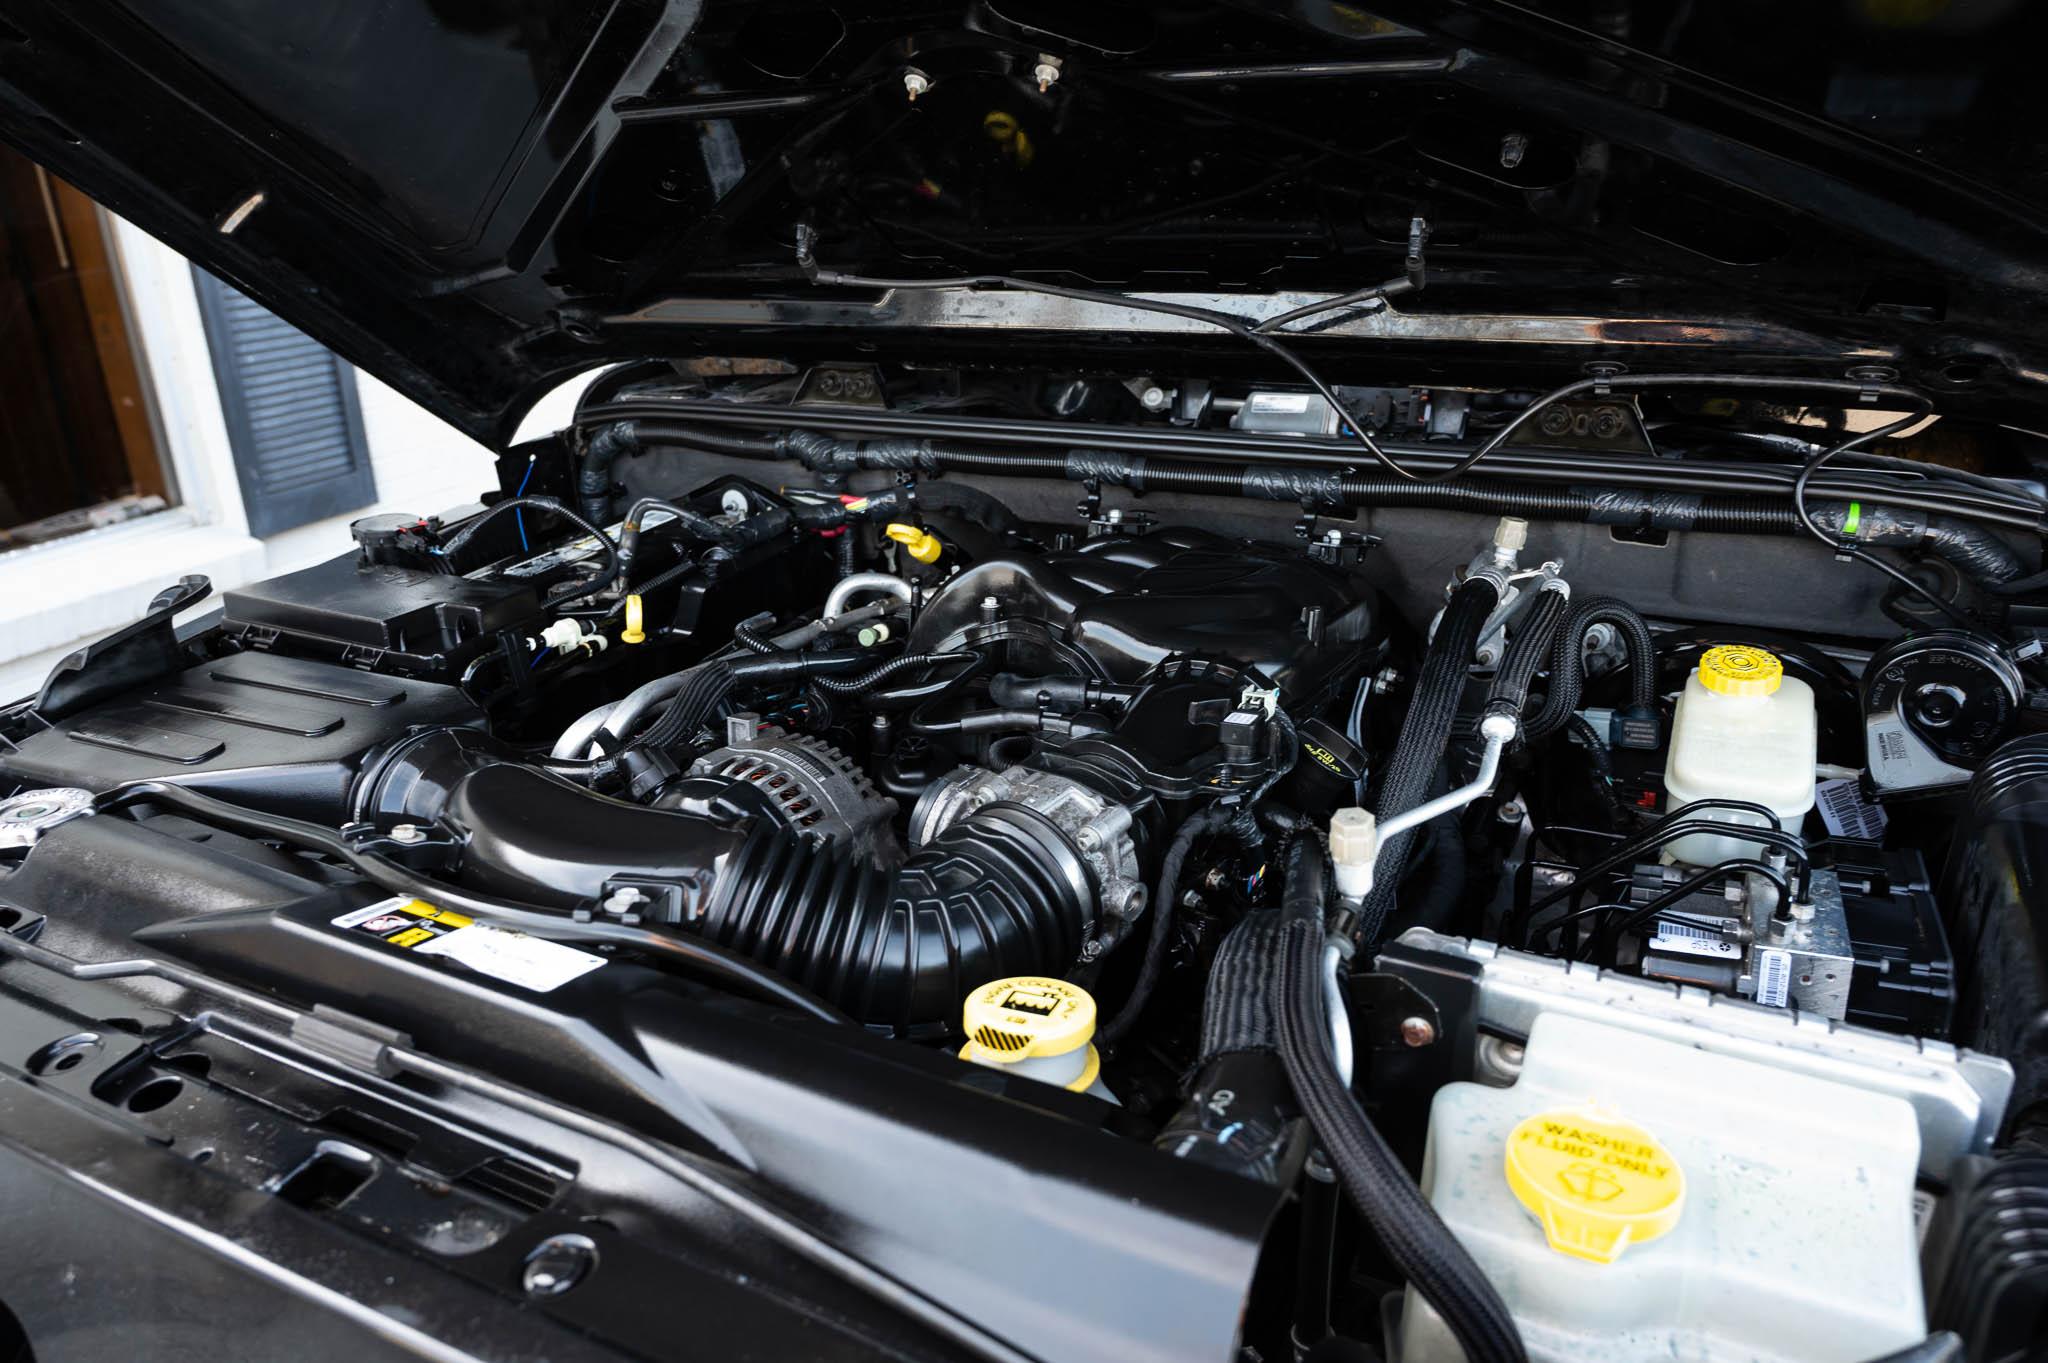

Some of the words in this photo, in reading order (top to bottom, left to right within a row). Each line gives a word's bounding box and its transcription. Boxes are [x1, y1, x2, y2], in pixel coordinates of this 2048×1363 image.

[984, 983, 1012, 1004] ENGINE
[1018, 980, 1074, 998] COOLANT
[1062, 1000, 1079, 1020] ONLY
[1520, 1131, 1595, 1158] FLUID
[1601, 1153, 1670, 1179] ONLY
[1544, 1122, 1654, 1159] WASHER
